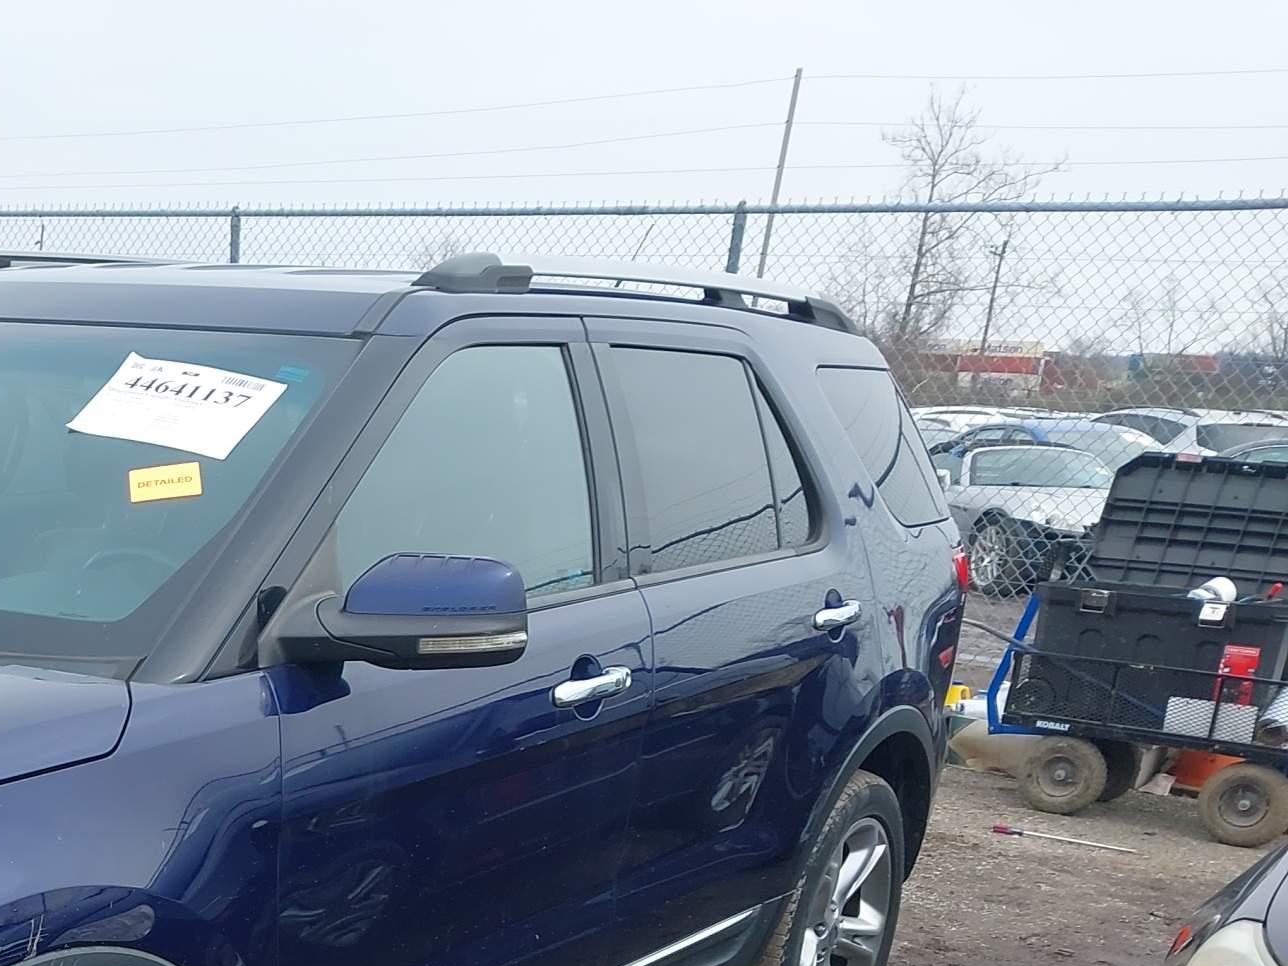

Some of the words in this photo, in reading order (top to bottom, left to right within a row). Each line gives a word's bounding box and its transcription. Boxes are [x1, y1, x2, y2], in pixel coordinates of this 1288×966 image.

[124, 375, 254, 409] 44641137
[137, 475, 193, 489] DETAILED
[1035, 720, 1071, 731] KOBALT
